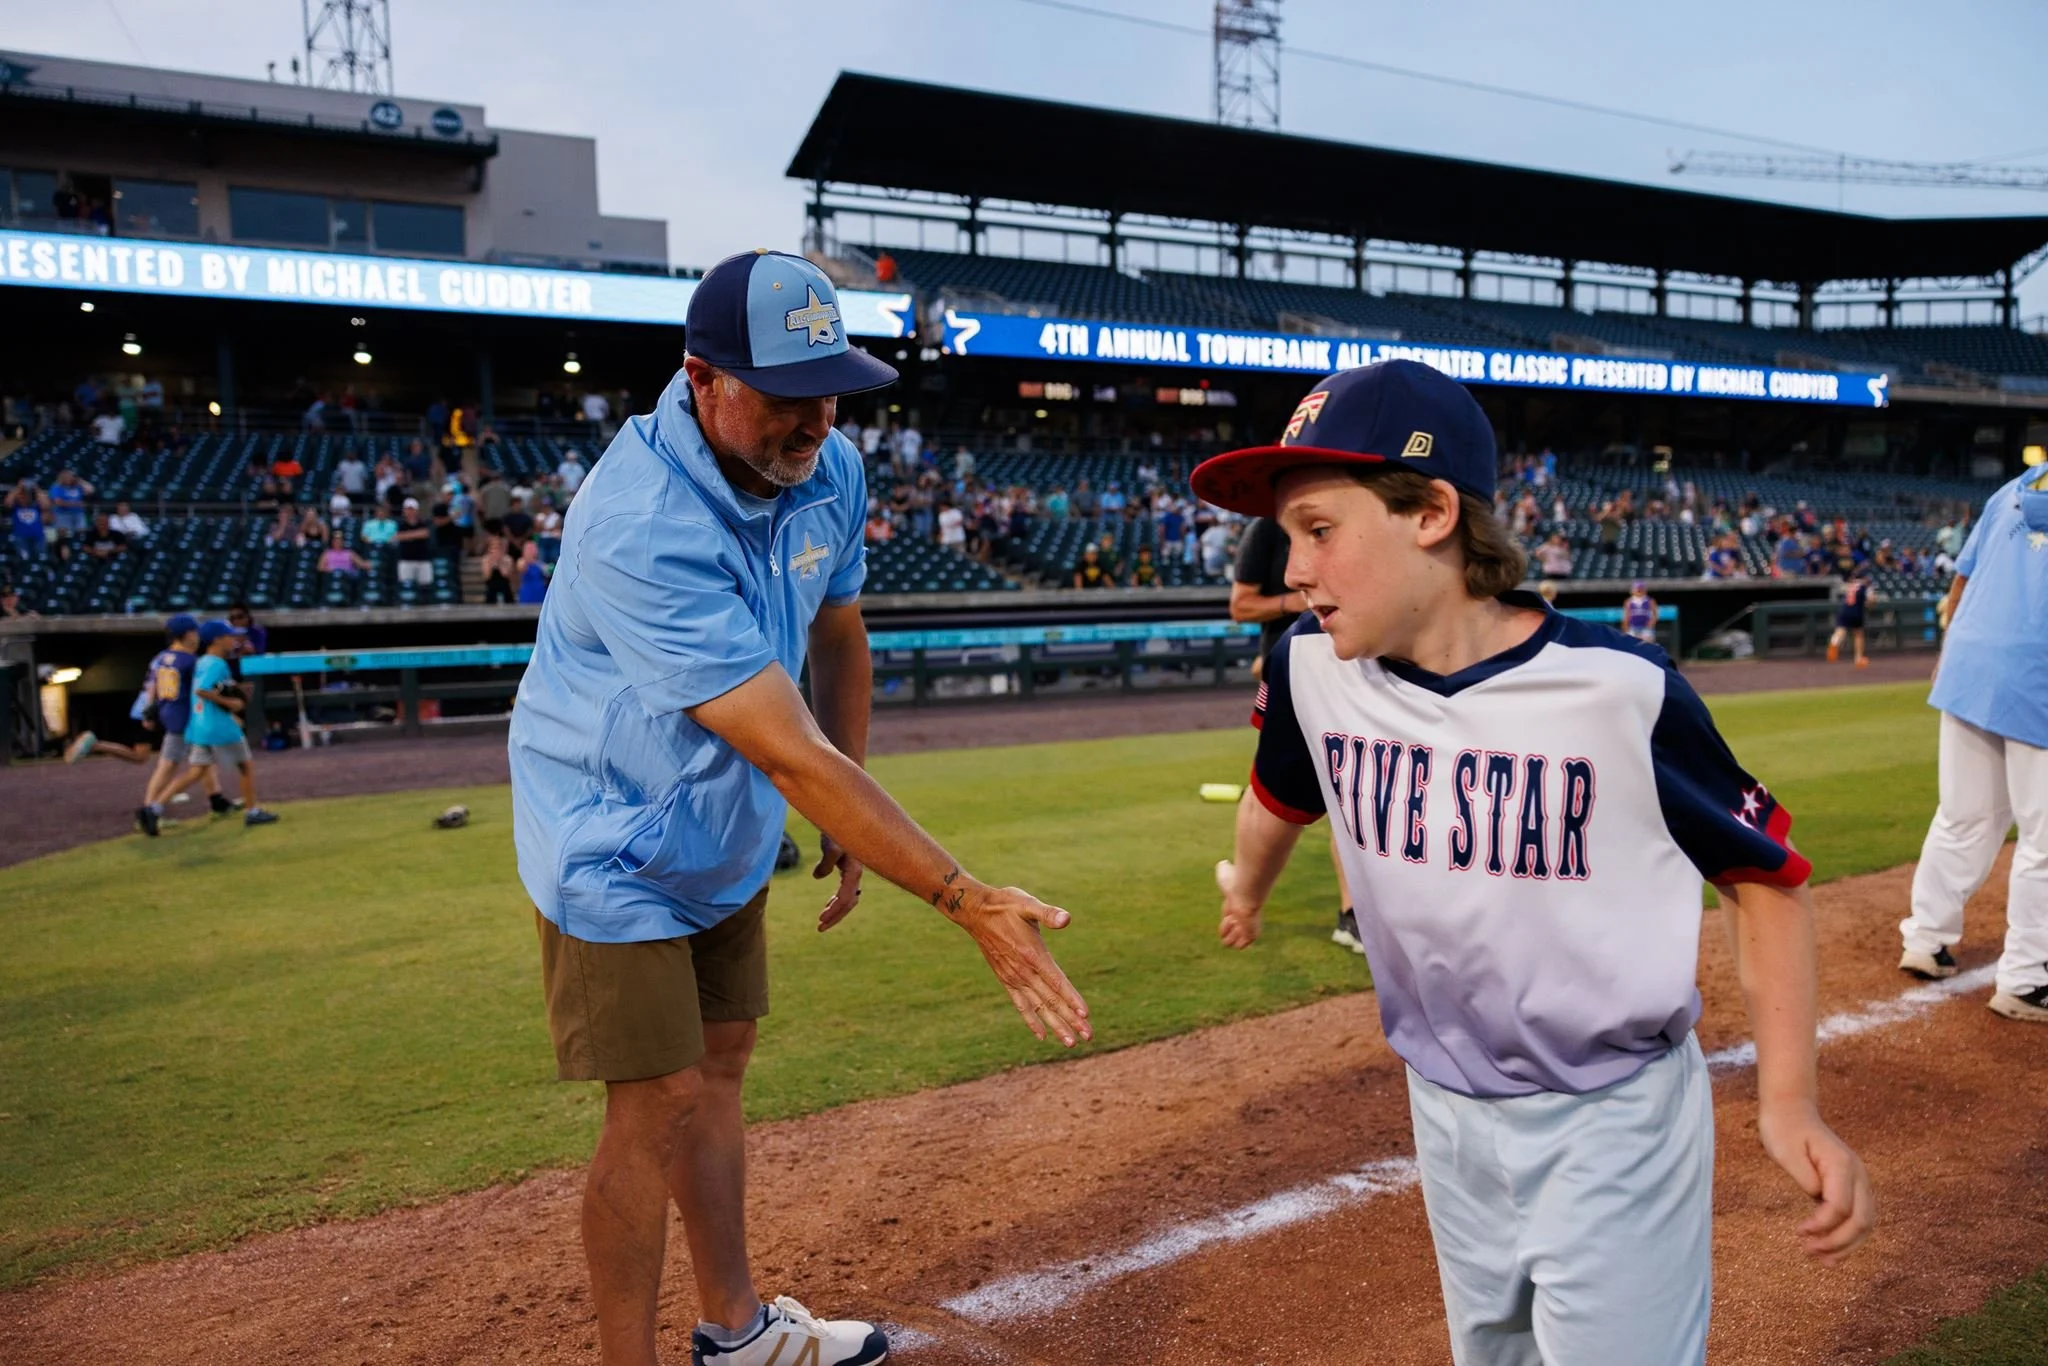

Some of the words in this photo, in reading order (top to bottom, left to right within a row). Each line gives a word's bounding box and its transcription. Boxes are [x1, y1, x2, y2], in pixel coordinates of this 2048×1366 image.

[200, 252, 250, 291] BY
[266, 257, 426, 302] MICHAEL
[439, 268, 592, 313] CUDDYER
[1039, 322, 1088, 356] 4TH
[1096, 326, 1191, 362] ANNUAL
[1196, 333, 1331, 370] TOWNEBANK
[1489, 352, 1568, 385] CLASSIC
[1571, 358, 1668, 391] PRESENTED
[1670, 364, 1695, 392] BY
[1697, 366, 1767, 396] MICHAEL
[1769, 371, 1839, 400] CUDDYER
[1322, 733, 1432, 863] FIVE
[1449, 749, 1596, 881] STAR
